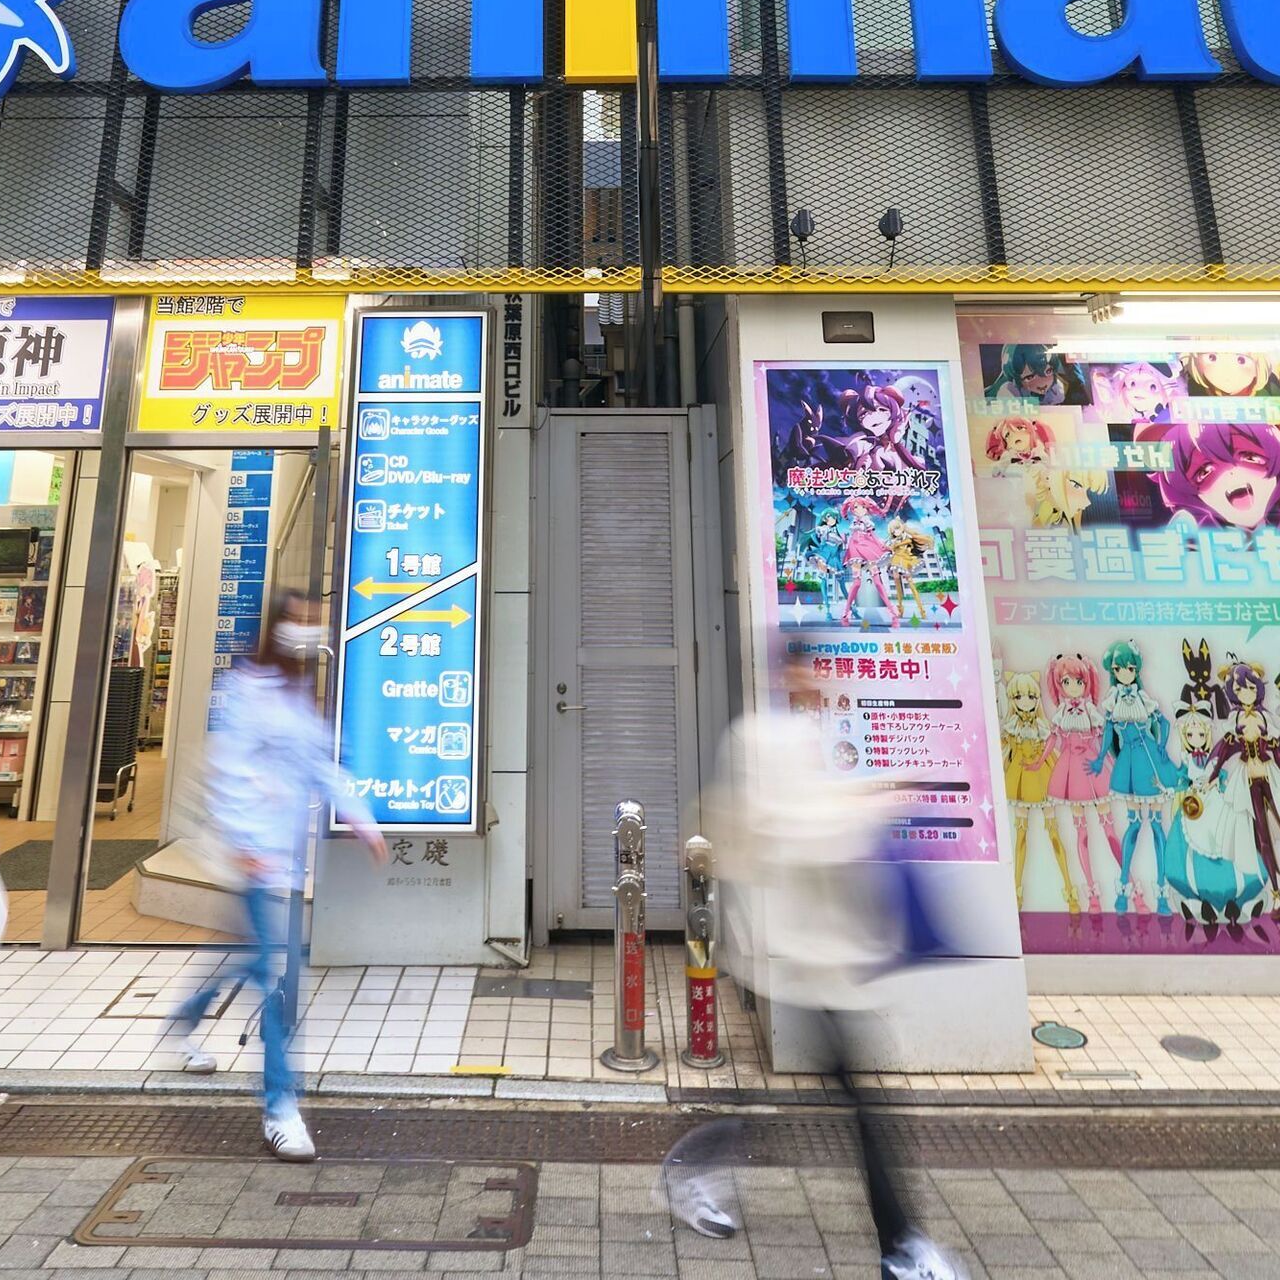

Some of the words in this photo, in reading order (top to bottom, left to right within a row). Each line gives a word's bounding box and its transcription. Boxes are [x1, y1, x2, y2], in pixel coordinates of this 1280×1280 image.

[156, 295, 246, 316] 当館2階で
[159, 326, 327, 391] ジャンプ
[377, 365, 463, 390] animate
[13, 380, 61, 399] Impact
[191, 403, 329, 425] グッズ展開中！
[390, 413, 480, 426] キャラクターグッズ
[389, 454, 409, 469] CD
[387, 470, 472, 485] DVD/Blu-ray
[787, 465, 942, 489] 魔法少女にあこがれて
[387, 503, 446, 520] チケット
[385, 546, 443, 577] 1号館
[379, 625, 442, 657] 2号館
[811, 656, 931, 681] 好評発売中!
[381, 679, 439, 699] Gratte
[386, 725, 437, 745] マンガ
[391, 838, 450, 867] 定礎
